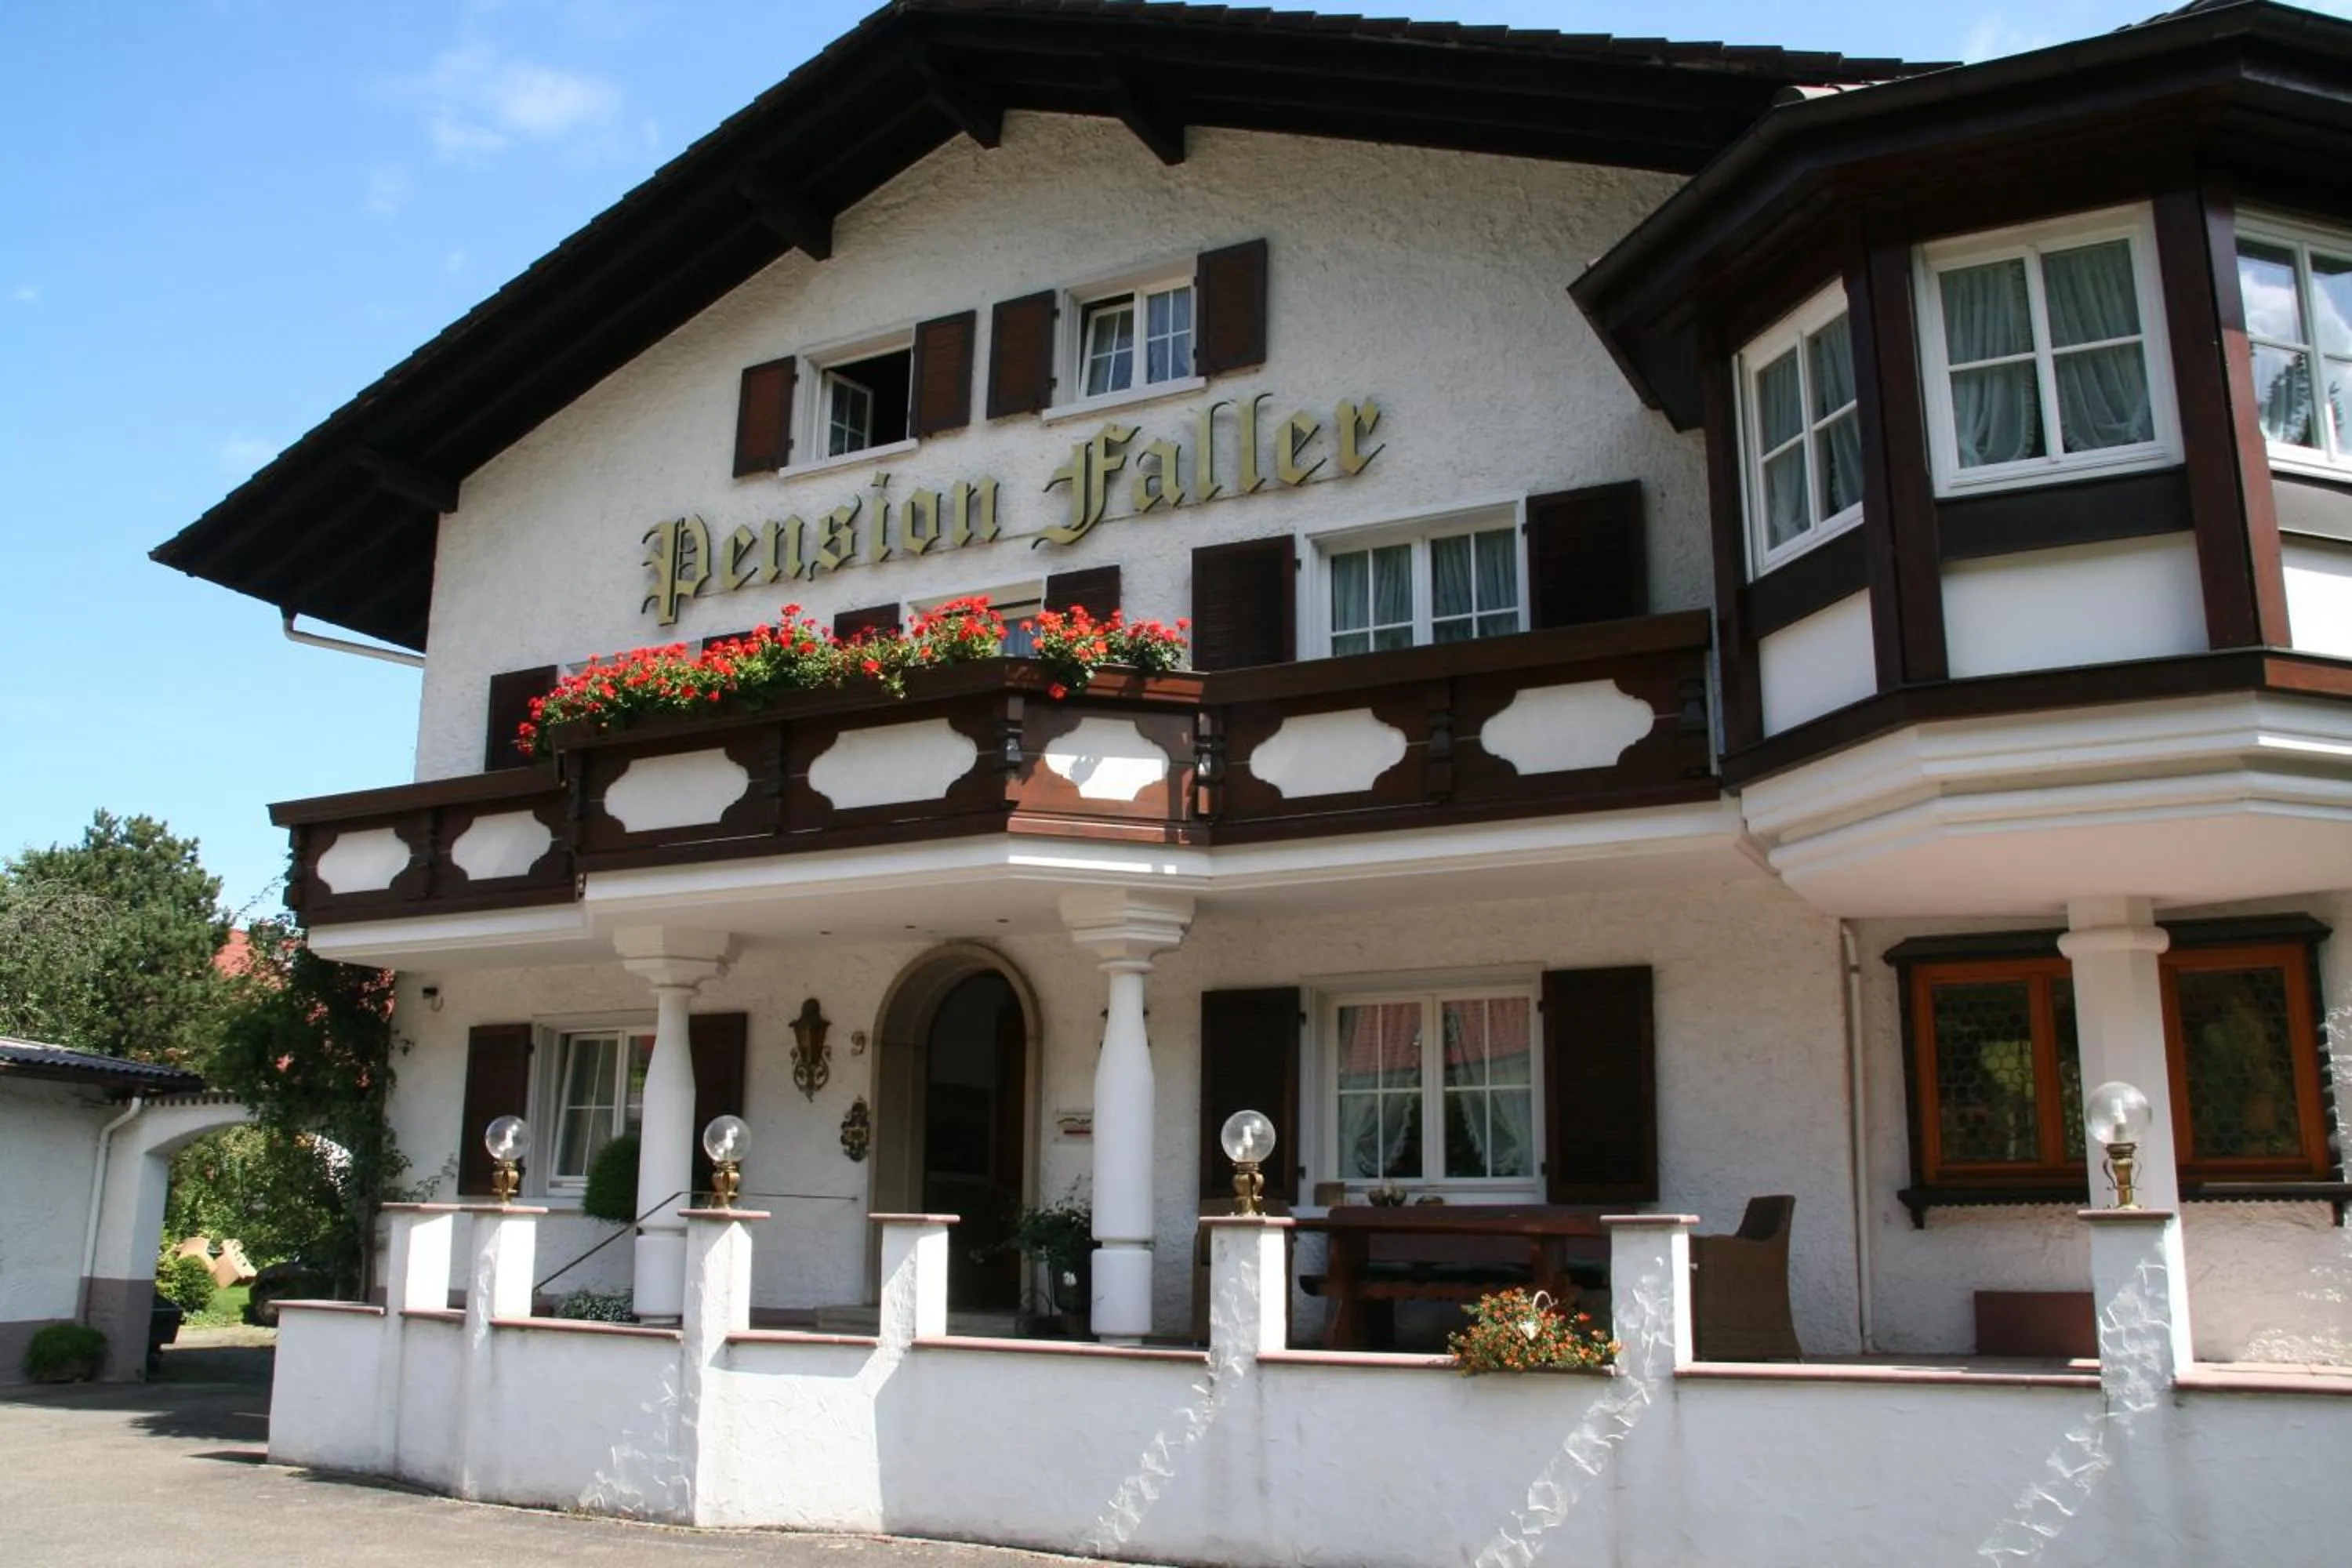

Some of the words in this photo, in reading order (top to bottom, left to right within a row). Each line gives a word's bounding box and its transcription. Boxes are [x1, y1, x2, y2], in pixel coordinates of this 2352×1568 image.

[641, 471, 1001, 626] Pension
[1032, 393, 1385, 549] Faller
[851, 1031, 866, 1056] 9
